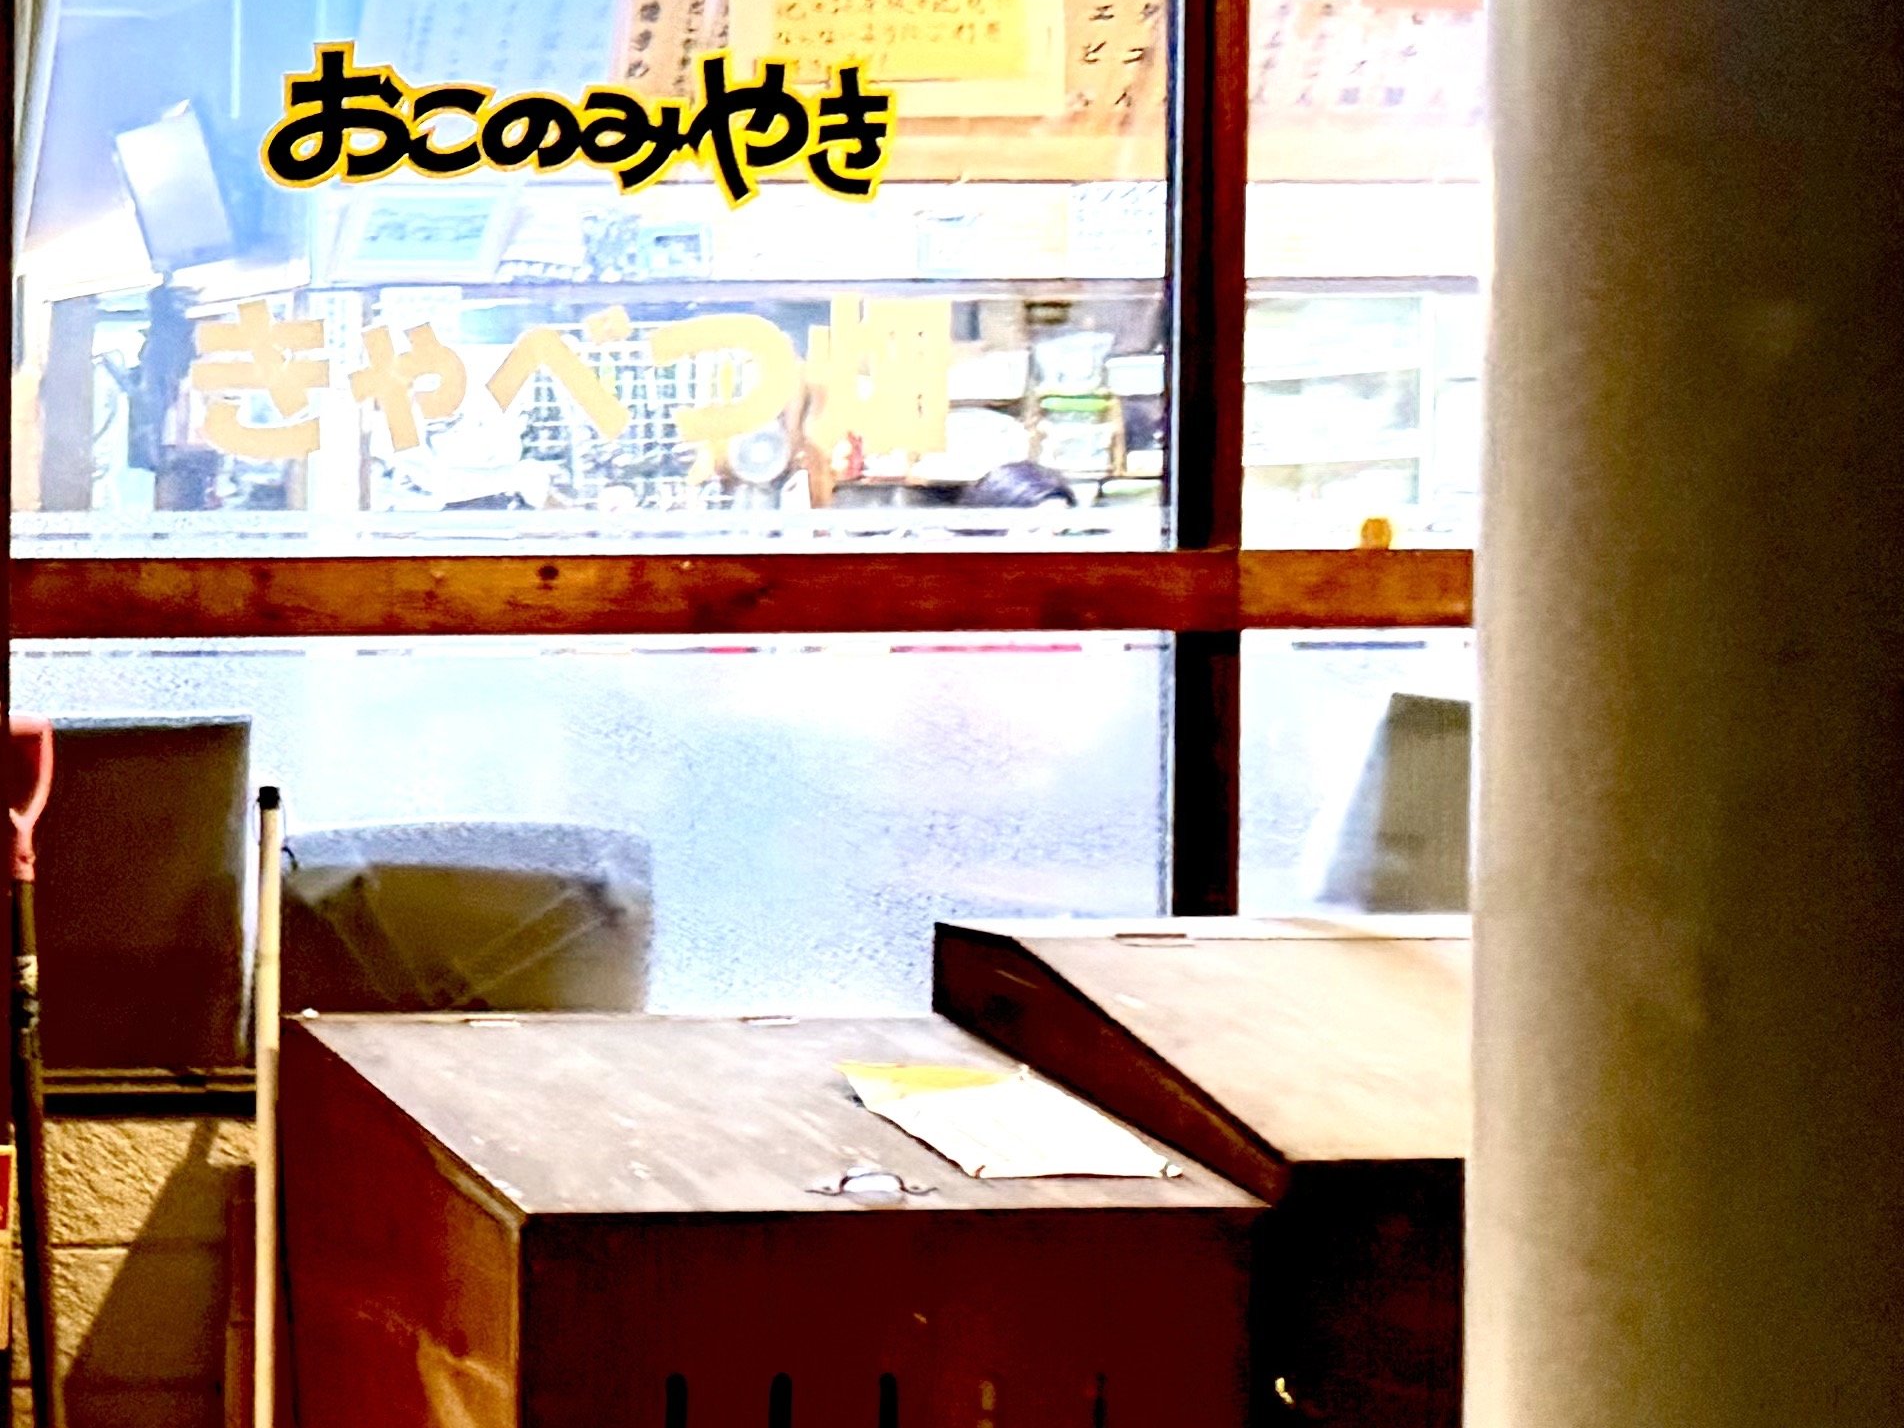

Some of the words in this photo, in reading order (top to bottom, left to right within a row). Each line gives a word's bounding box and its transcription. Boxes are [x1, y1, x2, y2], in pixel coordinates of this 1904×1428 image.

[264, 44, 894, 206] おこのみやき
